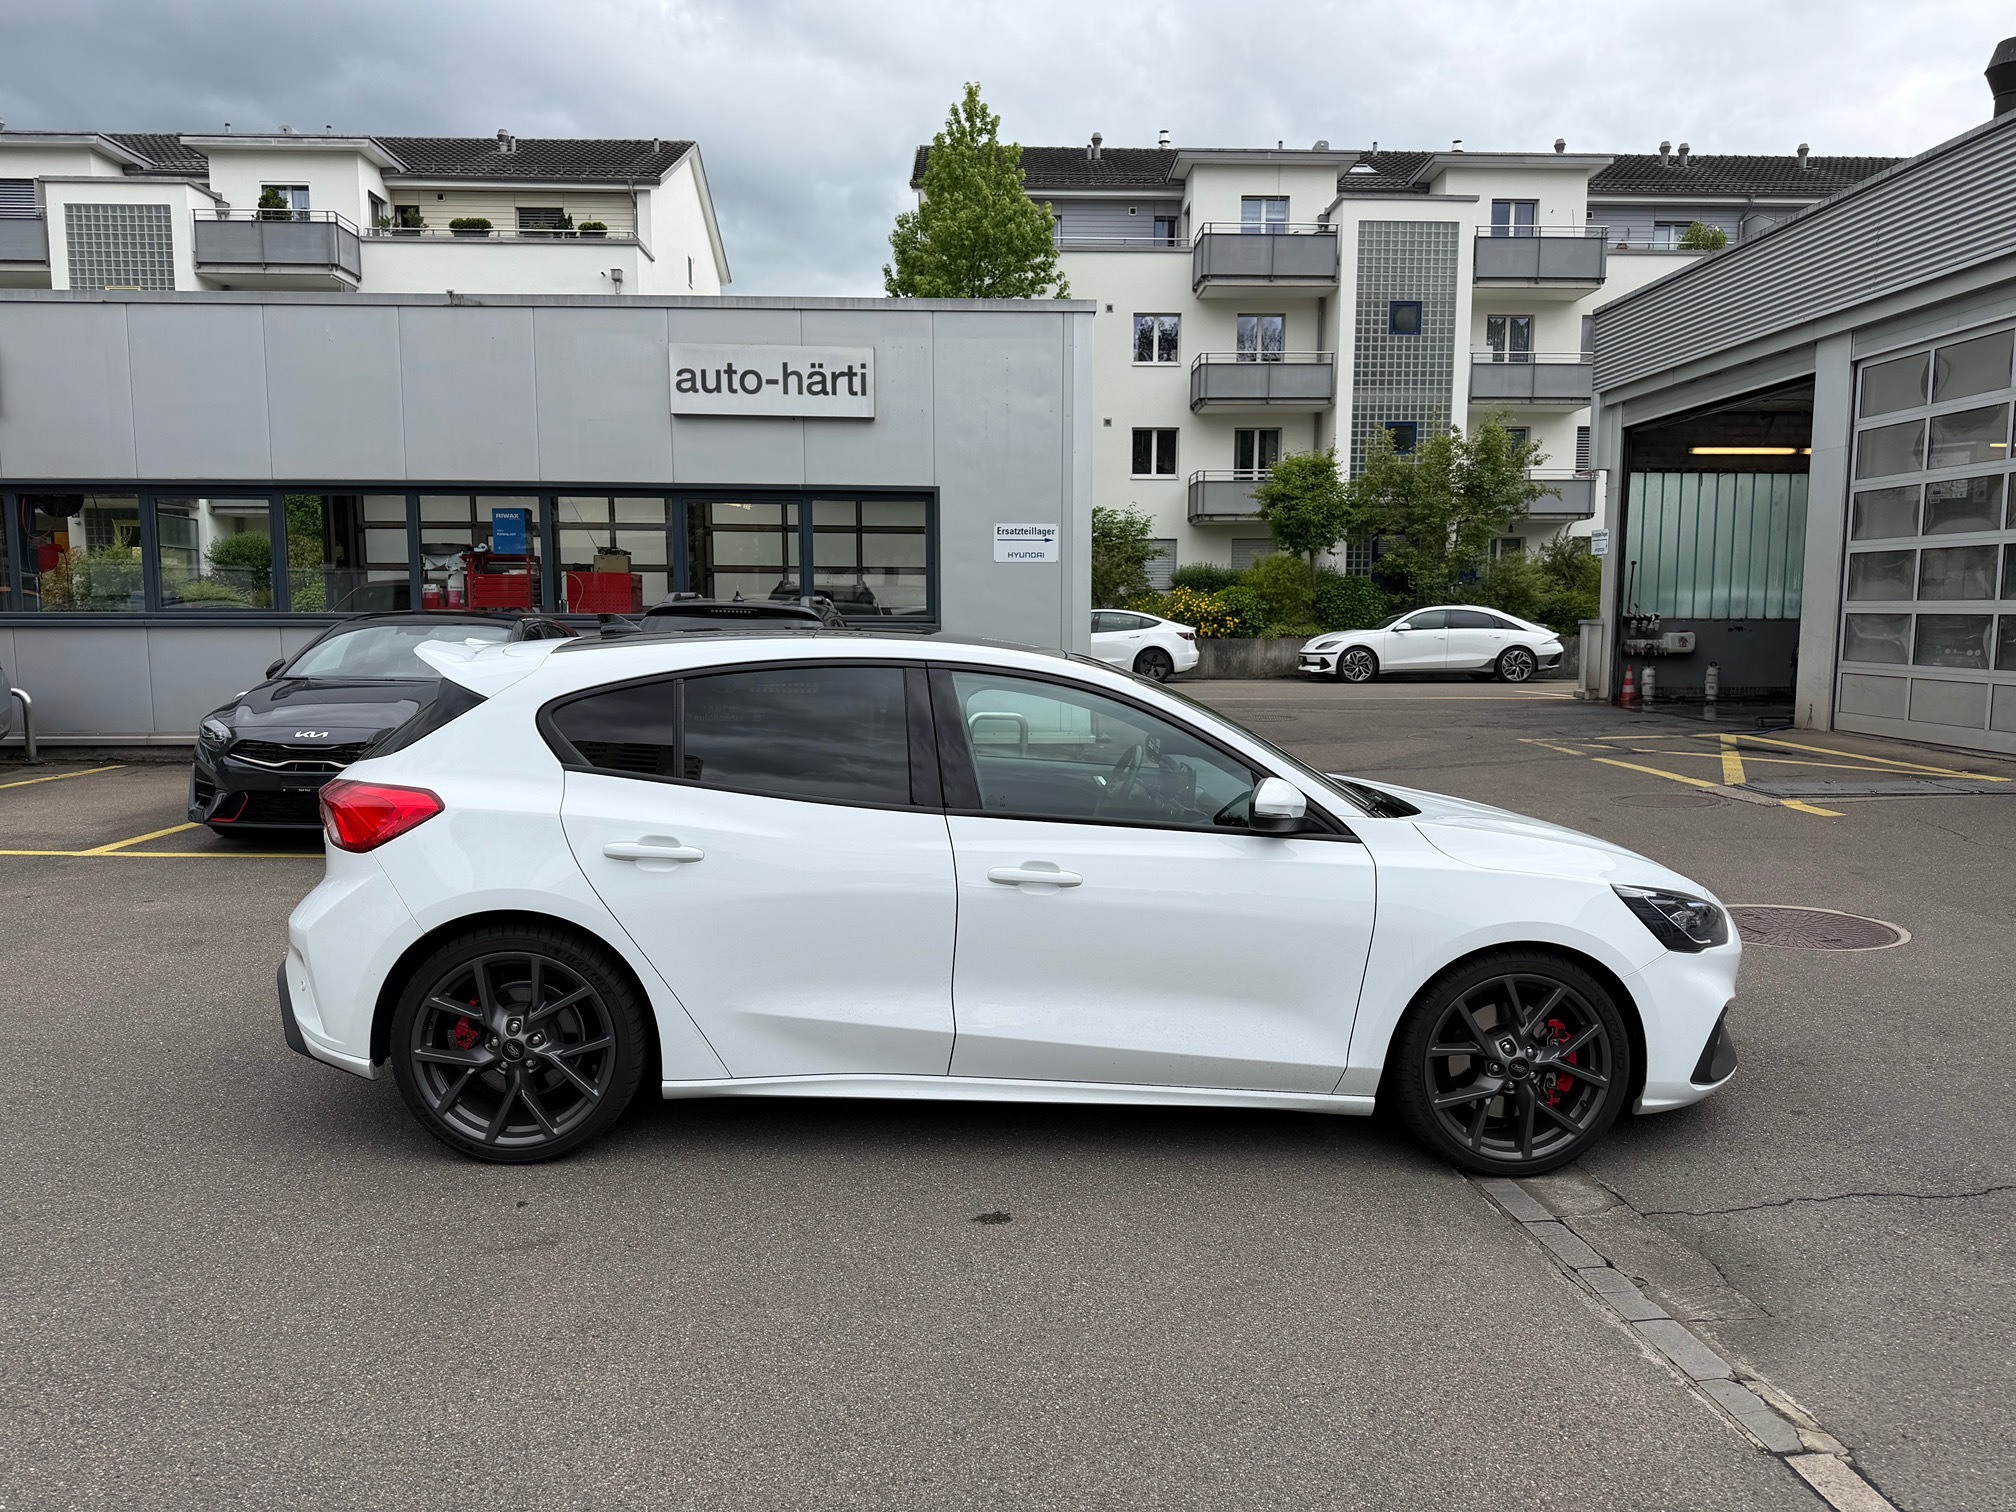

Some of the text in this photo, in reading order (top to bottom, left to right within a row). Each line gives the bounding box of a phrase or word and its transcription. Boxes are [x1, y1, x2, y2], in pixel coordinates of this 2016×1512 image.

[675, 361, 867, 396] auto-härti
[996, 526, 1056, 537] Ersatzteillager
[1007, 551, 1045, 559] HYUNDAI
